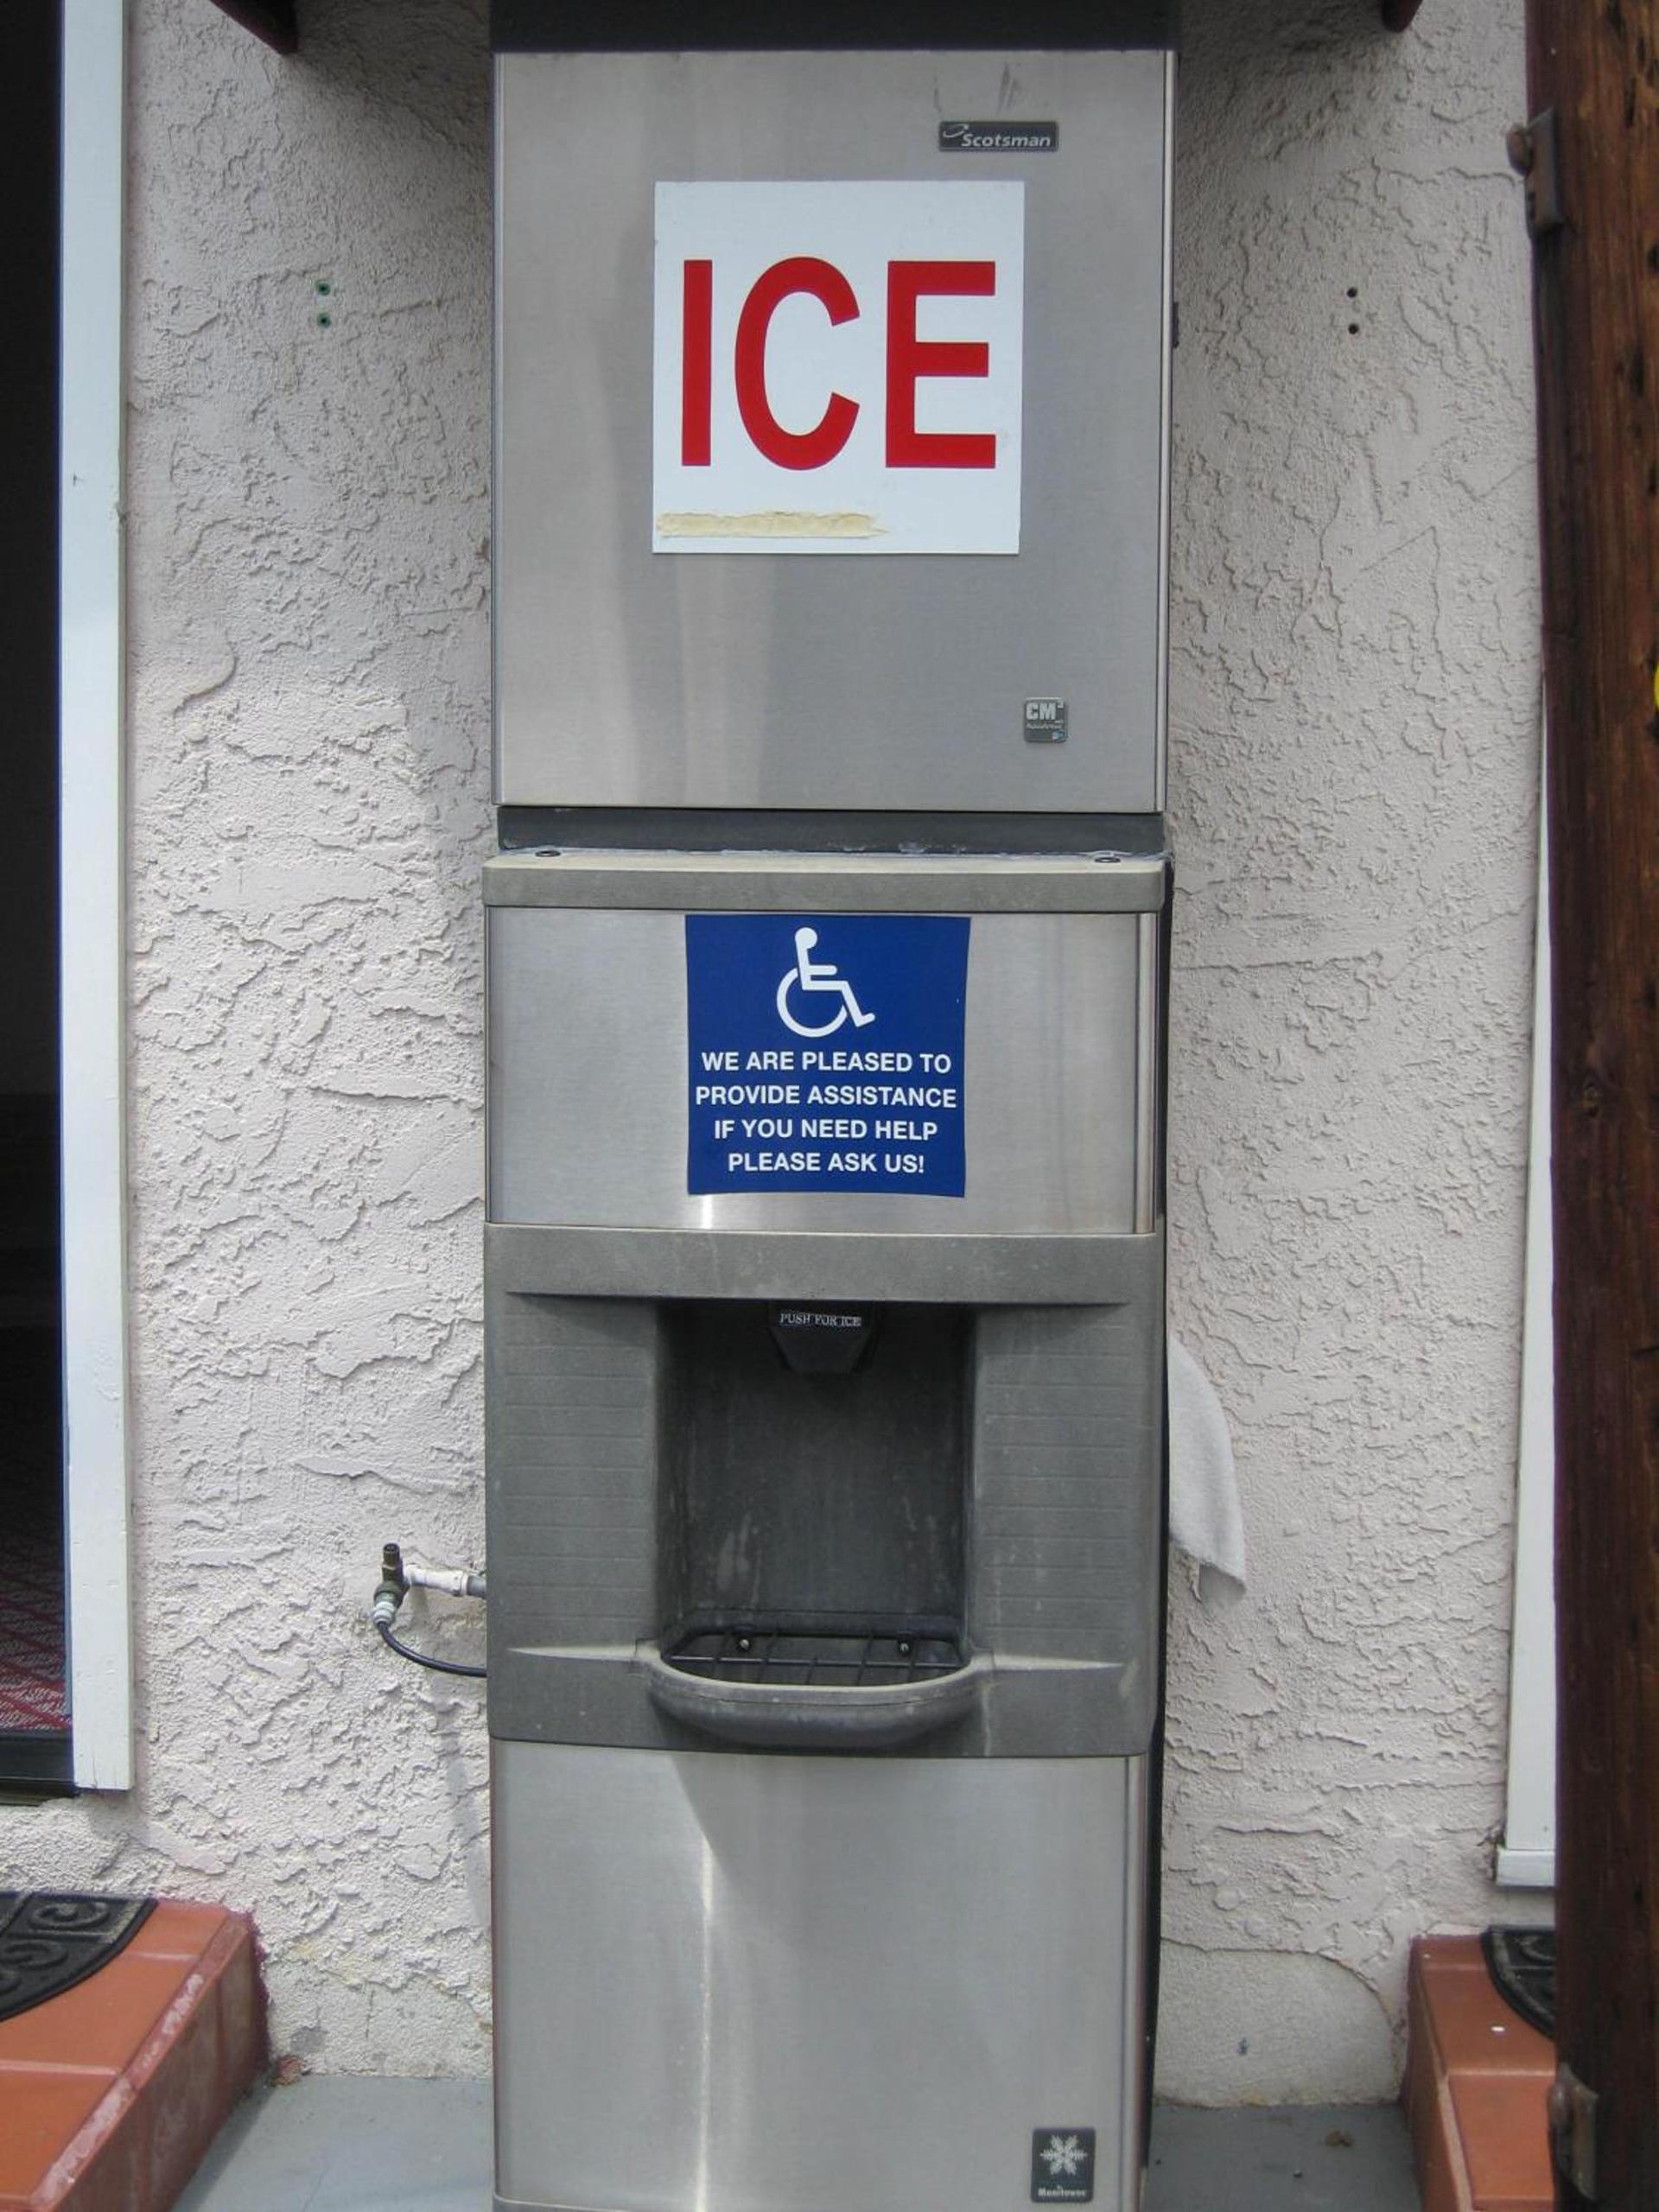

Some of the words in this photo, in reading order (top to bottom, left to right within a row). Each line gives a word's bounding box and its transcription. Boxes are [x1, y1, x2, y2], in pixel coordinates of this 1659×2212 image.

[961, 133, 1051, 147] Scotsman
[681, 256, 996, 471] ICE
[701, 1052, 740, 1071] WE
[746, 1052, 794, 1071] ARE
[802, 1052, 913, 1073] PLEASED
[919, 1053, 951, 1074] TO
[696, 1085, 800, 1105] PROVIDE
[806, 1085, 957, 1108] ASSISTANCE
[715, 1120, 734, 1139] IF
[741, 1119, 793, 1139] YOU
[801, 1119, 868, 1139] NEED
[874, 1120, 938, 1141] HELP
[728, 1153, 821, 1172] PLEASE
[827, 1153, 877, 1172] ASK
[885, 1154, 925, 1173] US!
[779, 1313, 810, 1325] PUSH
[815, 1313, 838, 1326] FOR
[841, 1316, 862, 1327] ICE
